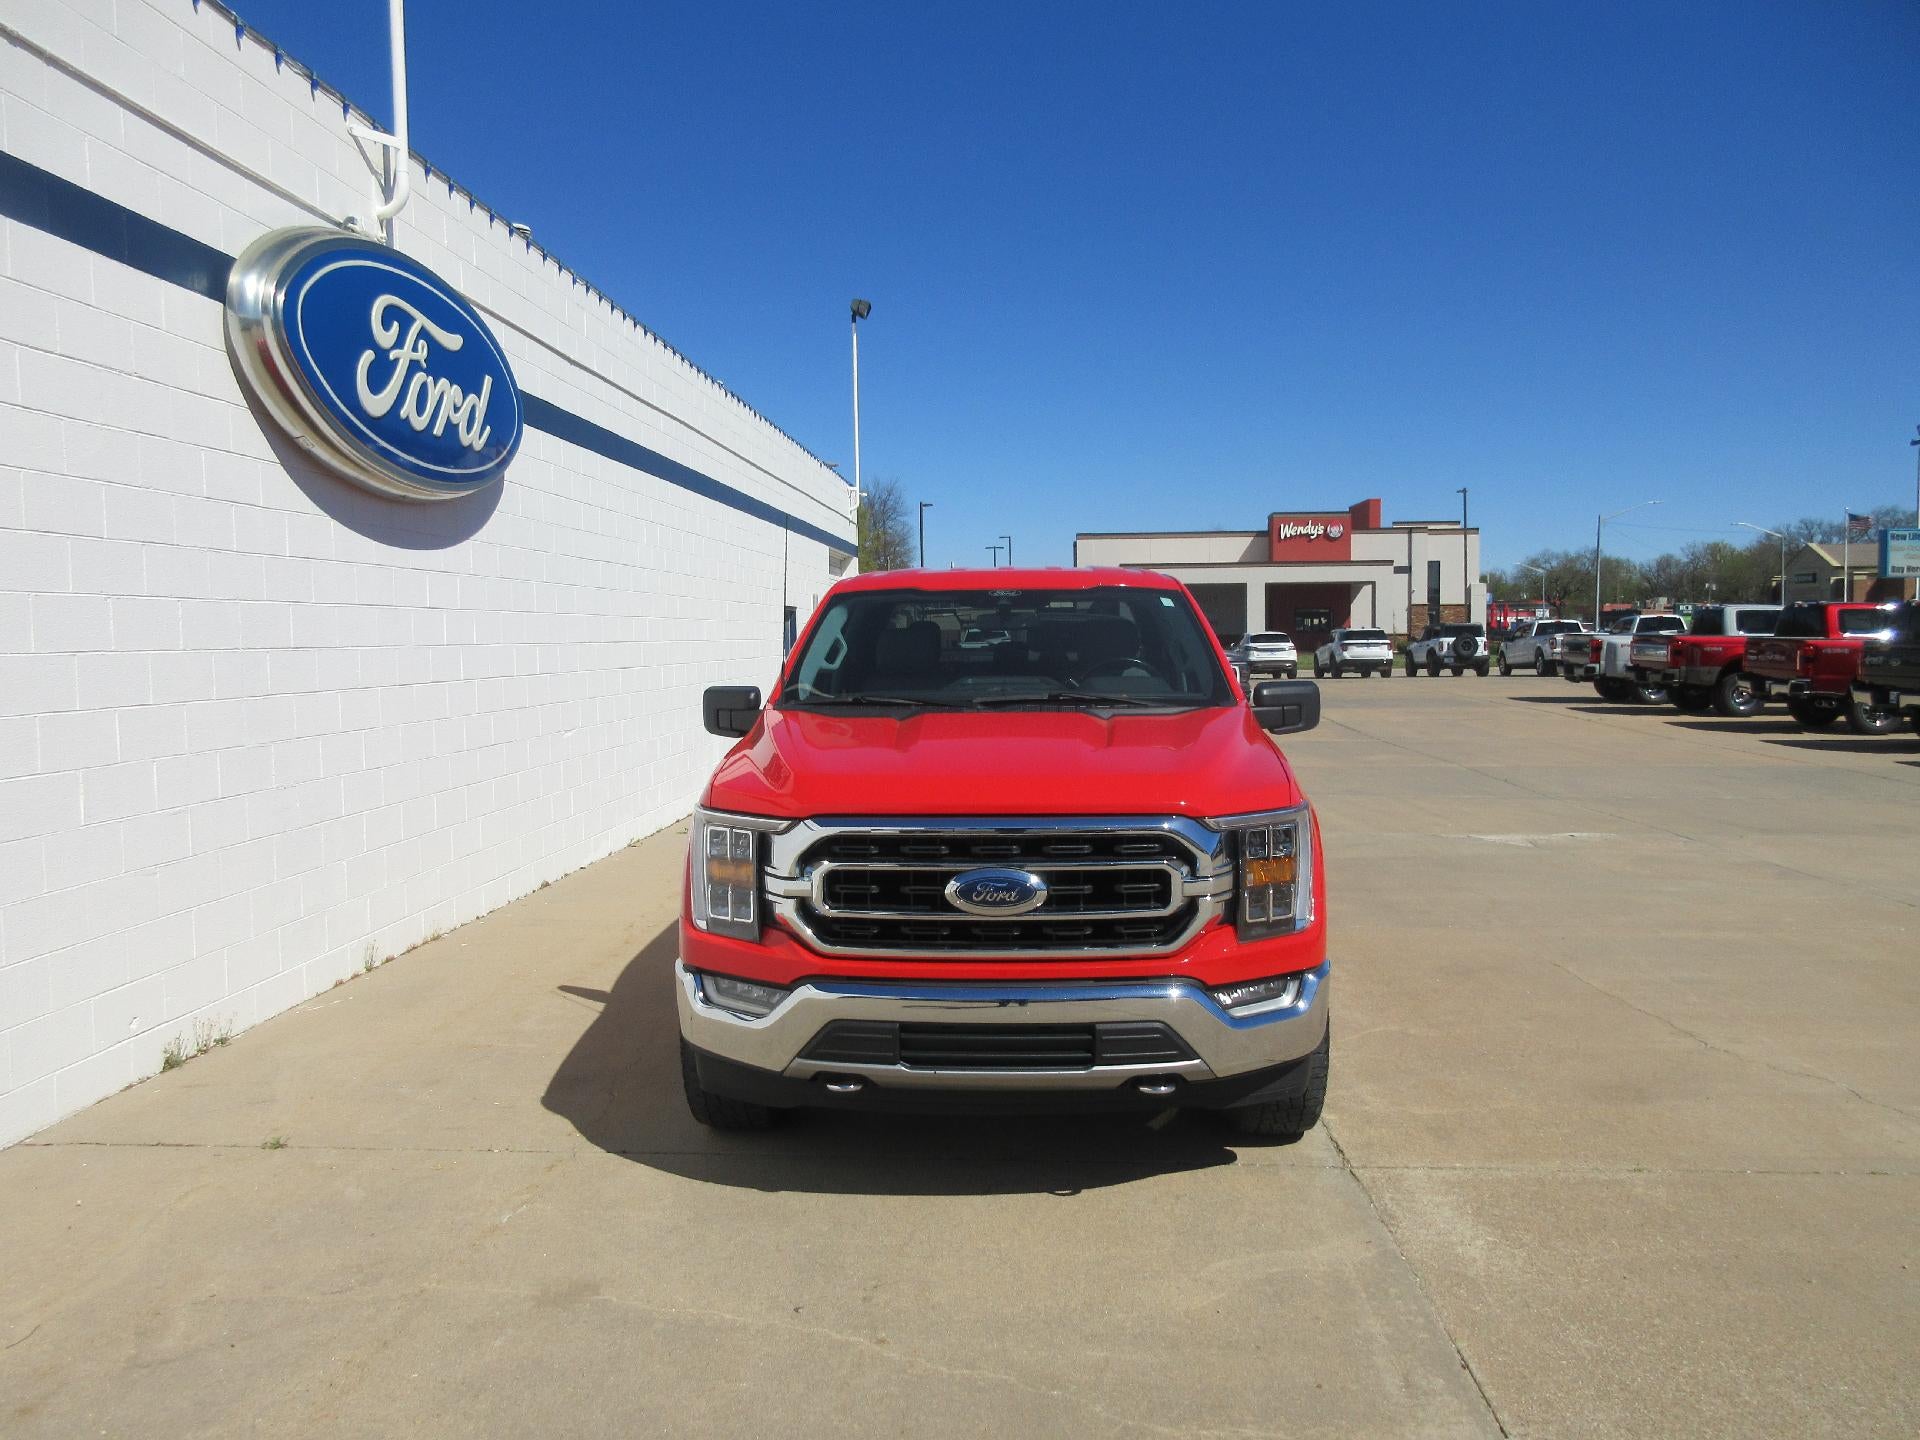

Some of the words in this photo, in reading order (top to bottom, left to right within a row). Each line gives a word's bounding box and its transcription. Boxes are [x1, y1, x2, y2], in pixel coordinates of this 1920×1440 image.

[356, 294, 493, 451] Ford
[1280, 519, 1325, 540] Wendy's
[972, 881, 1020, 902] Ford
